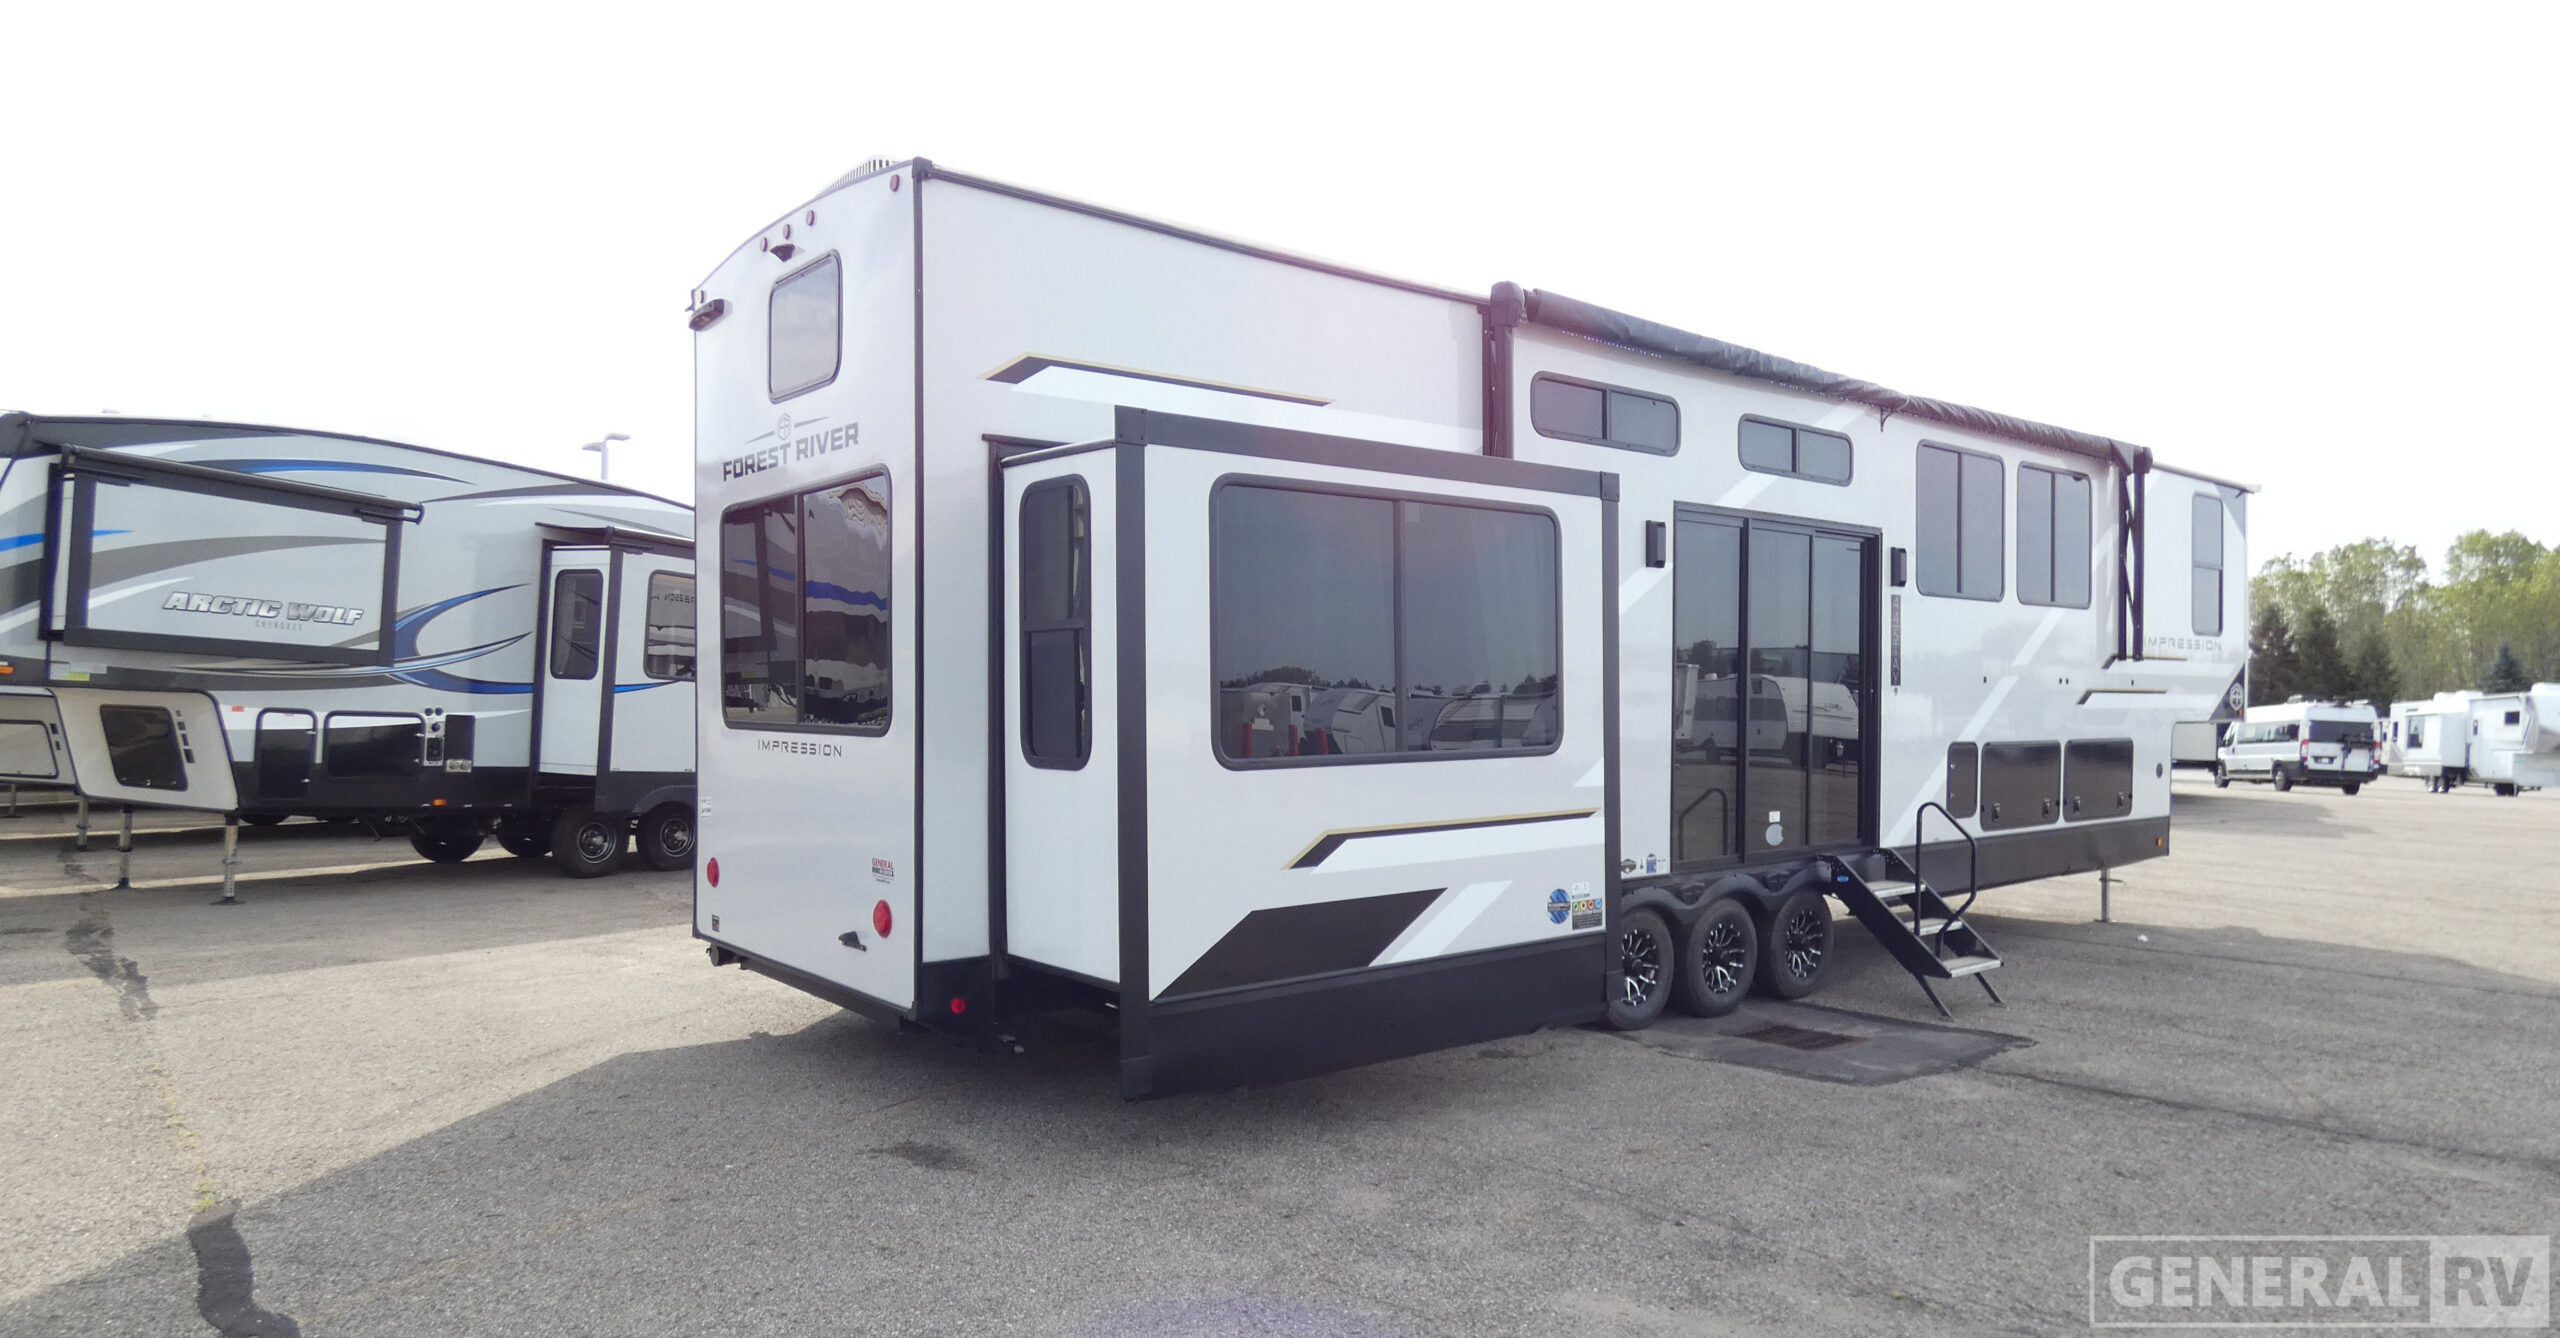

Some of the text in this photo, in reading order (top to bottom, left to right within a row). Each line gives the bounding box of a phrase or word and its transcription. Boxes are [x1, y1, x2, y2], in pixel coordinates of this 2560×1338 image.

[722, 421, 859, 481] FOREST RIVER
[162, 591, 364, 625] ARCTIC WOLF
[2143, 637, 2222, 651] IMPRESSION
[757, 739, 843, 757] IMPRESSION
